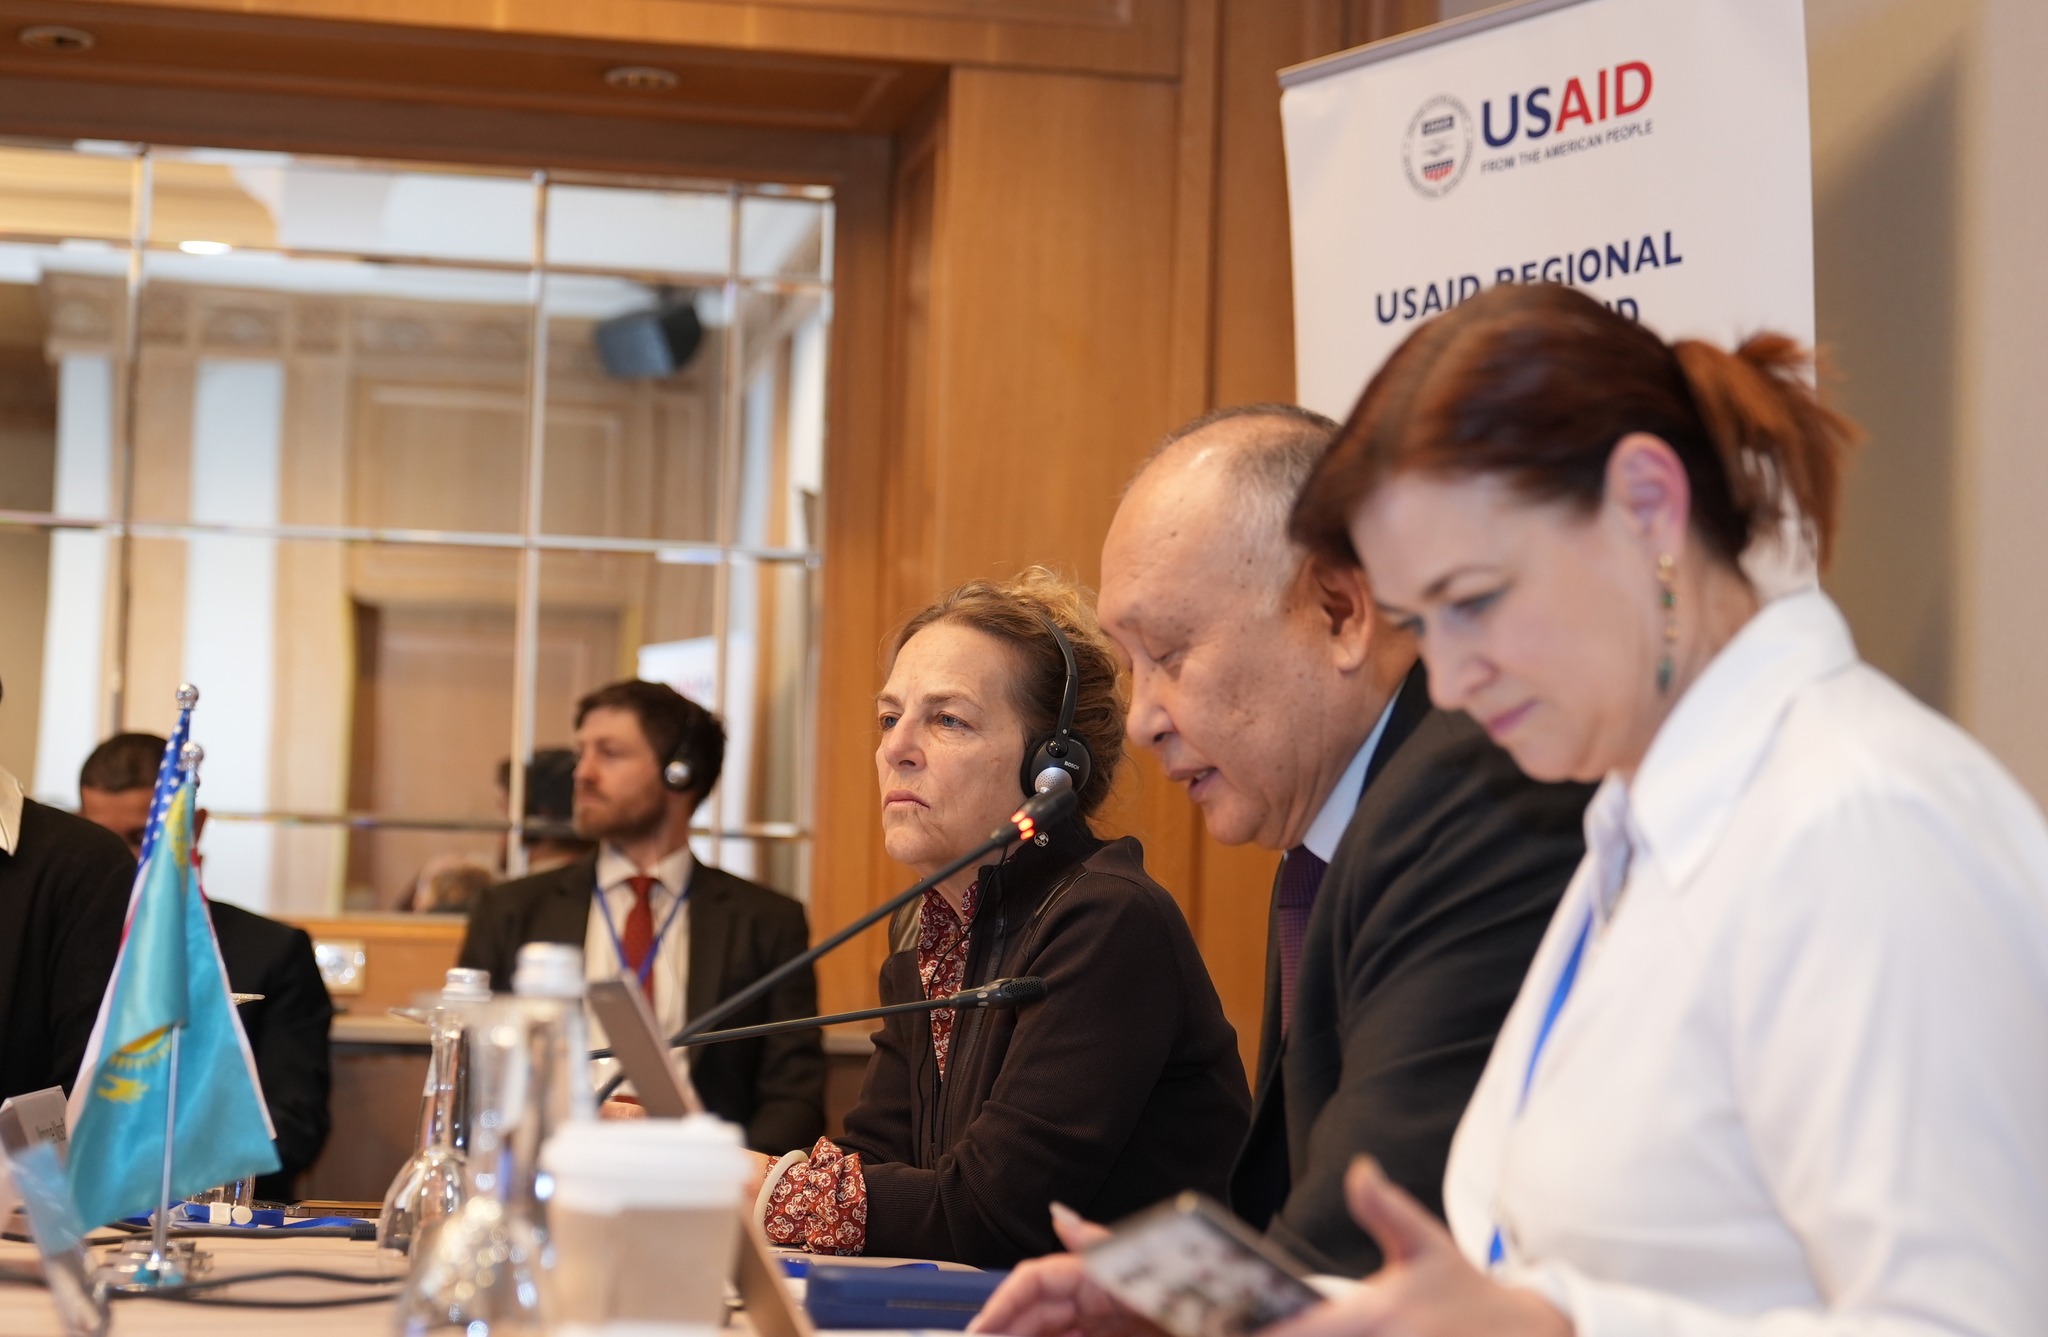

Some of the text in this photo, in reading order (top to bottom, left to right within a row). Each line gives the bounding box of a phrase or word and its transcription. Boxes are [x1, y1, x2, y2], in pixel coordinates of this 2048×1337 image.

[1482, 61, 1653, 147] USAID
[1481, 119, 1654, 174] FROM THE AMERICAN PEOPLE
[1375, 274, 1481, 324] USAID
[1064, 760, 1080, 770] BOSCH
